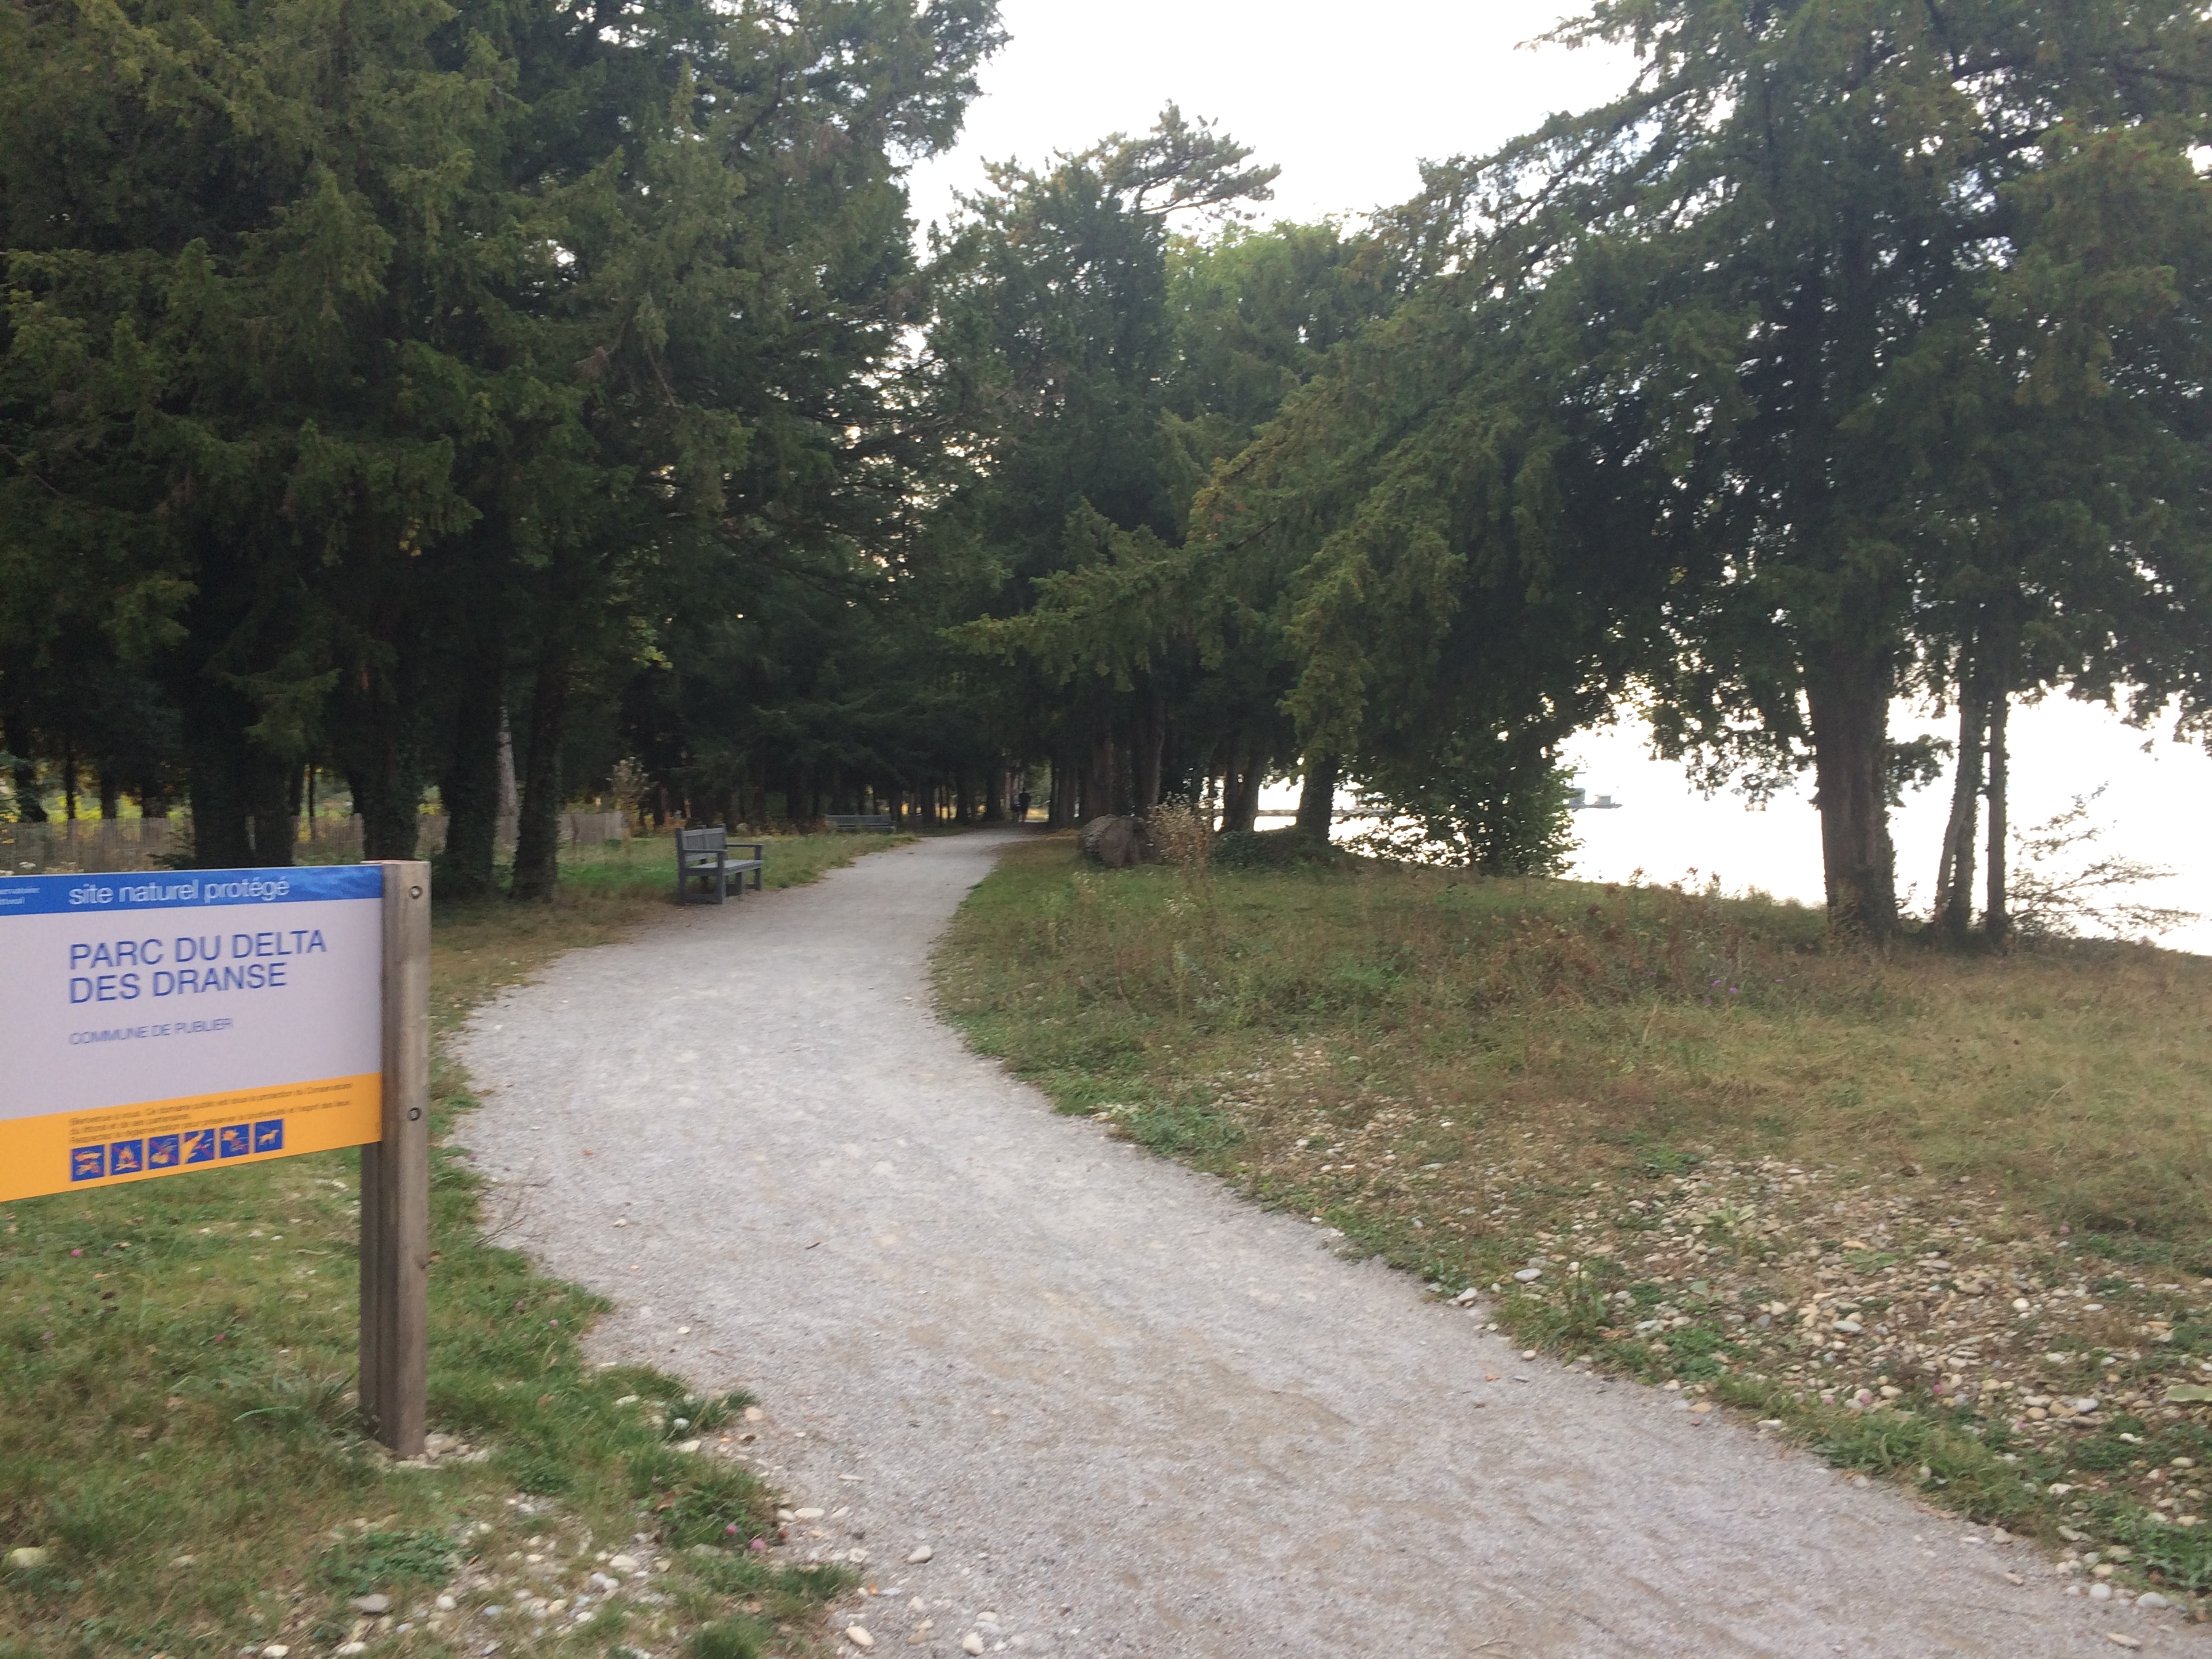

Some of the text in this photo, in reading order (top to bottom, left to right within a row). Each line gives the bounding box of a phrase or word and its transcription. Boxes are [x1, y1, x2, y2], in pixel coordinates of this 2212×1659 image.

[68, 876, 289, 905] site naturel protégé
[70, 929, 327, 970] PARC DU DELTA
[70, 962, 287, 1004] DES DRANSE
[68, 1018, 233, 1045] COMMUNE DE PUBLIER
